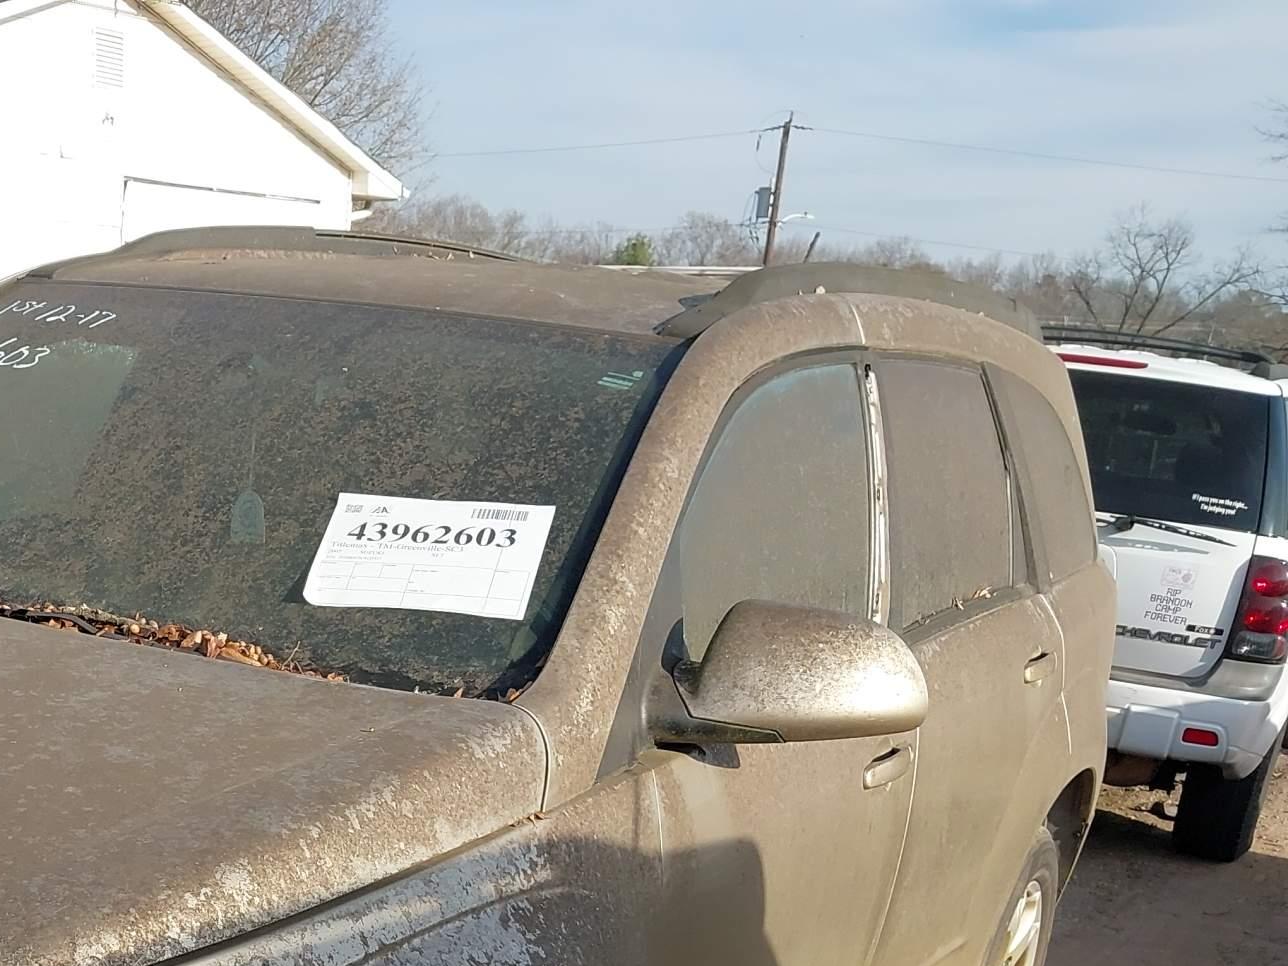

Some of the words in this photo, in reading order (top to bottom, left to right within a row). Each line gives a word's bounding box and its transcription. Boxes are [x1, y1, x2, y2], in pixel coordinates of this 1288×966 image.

[34, 304, 117, 328] 12-17
[346, 521, 518, 549] 43962603
[1166, 587, 1182, 597] RIP
[1149, 593, 1193, 609] BRANDON
[1154, 603, 1182, 615] CAMP
[1143, 610, 1188, 626] FOREVER
